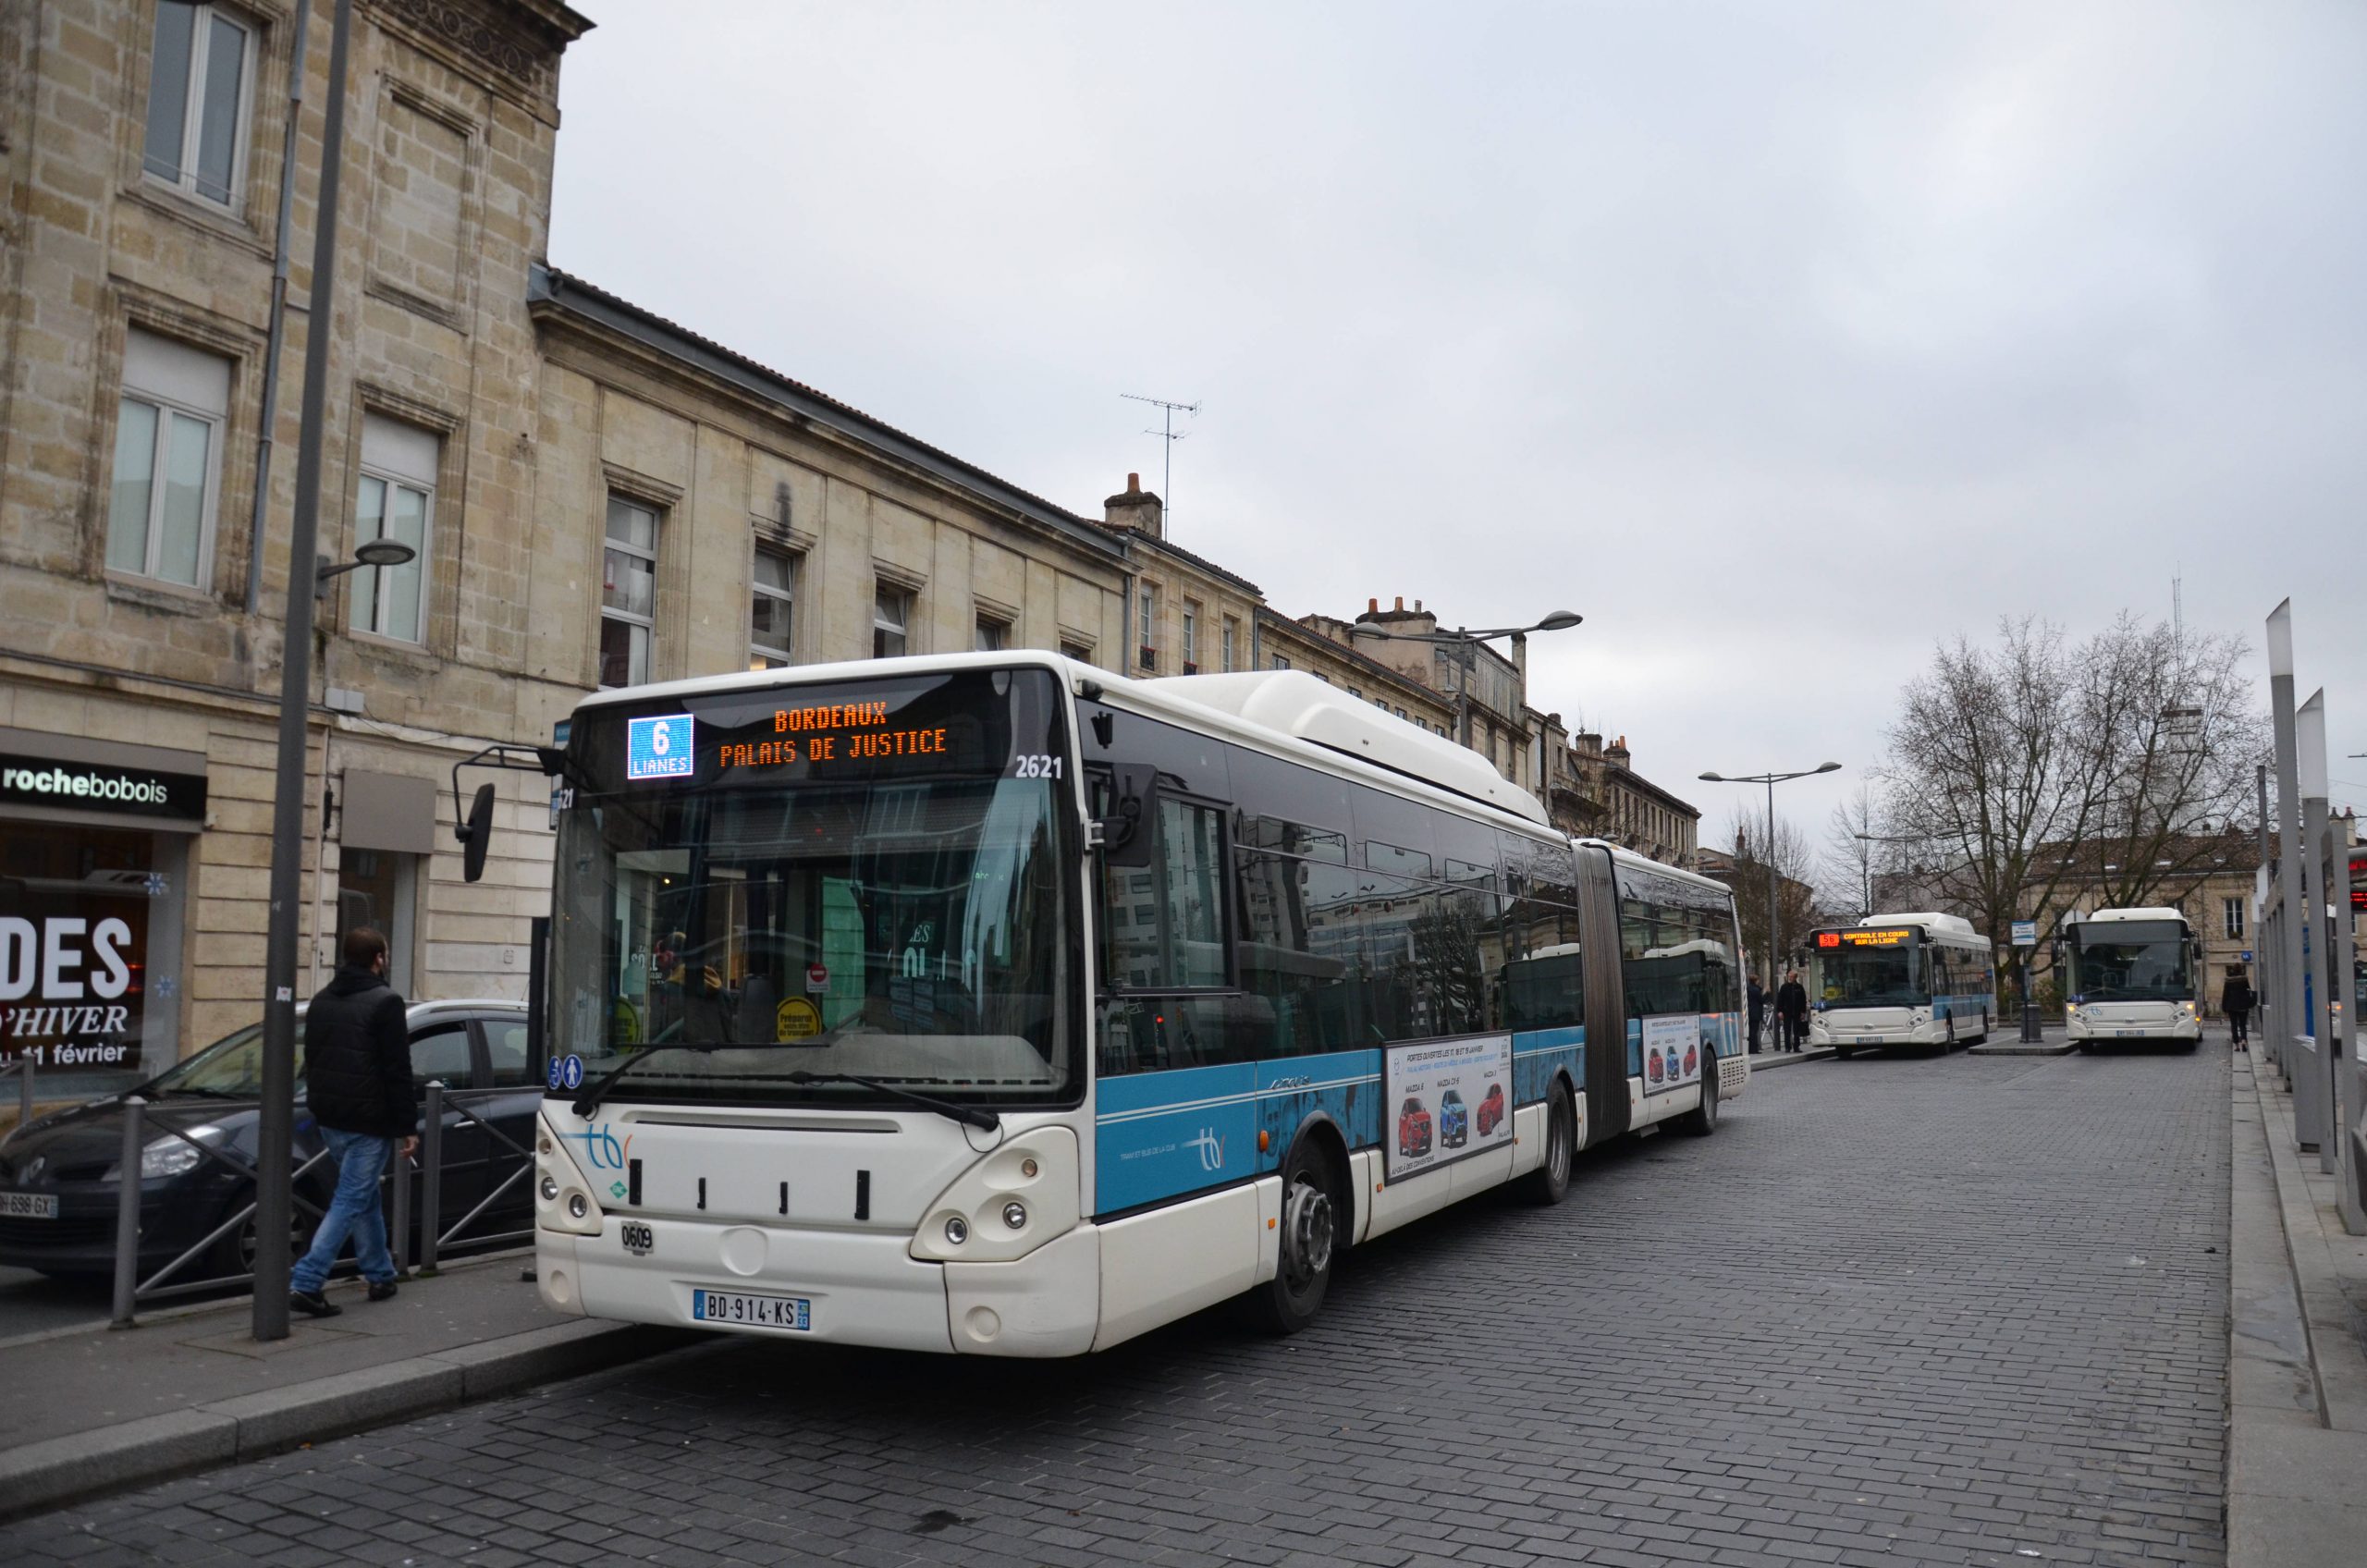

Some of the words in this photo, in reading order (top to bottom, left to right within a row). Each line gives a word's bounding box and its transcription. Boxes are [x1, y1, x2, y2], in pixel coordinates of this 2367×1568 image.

[775, 701, 887, 733] BORDEAUX
[652, 721, 670, 755] 6
[720, 741, 797, 768] PALAIS
[810, 738, 835, 762] DE
[849, 729, 947, 758] JUSTICE
[633, 756, 688, 775] LIANES
[1015, 754, 1062, 779] 2621
[3, 767, 167, 803] rochebobois
[1823, 935, 1834, 943] 56
[1844, 932, 1877, 940] CONTROLE
[0, 1005, 129, 1036] 'HIVER
[53, 1042, 128, 1064] février
[622, 1225, 652, 1248] 0609
[708, 1295, 794, 1324] BD-914-KS
